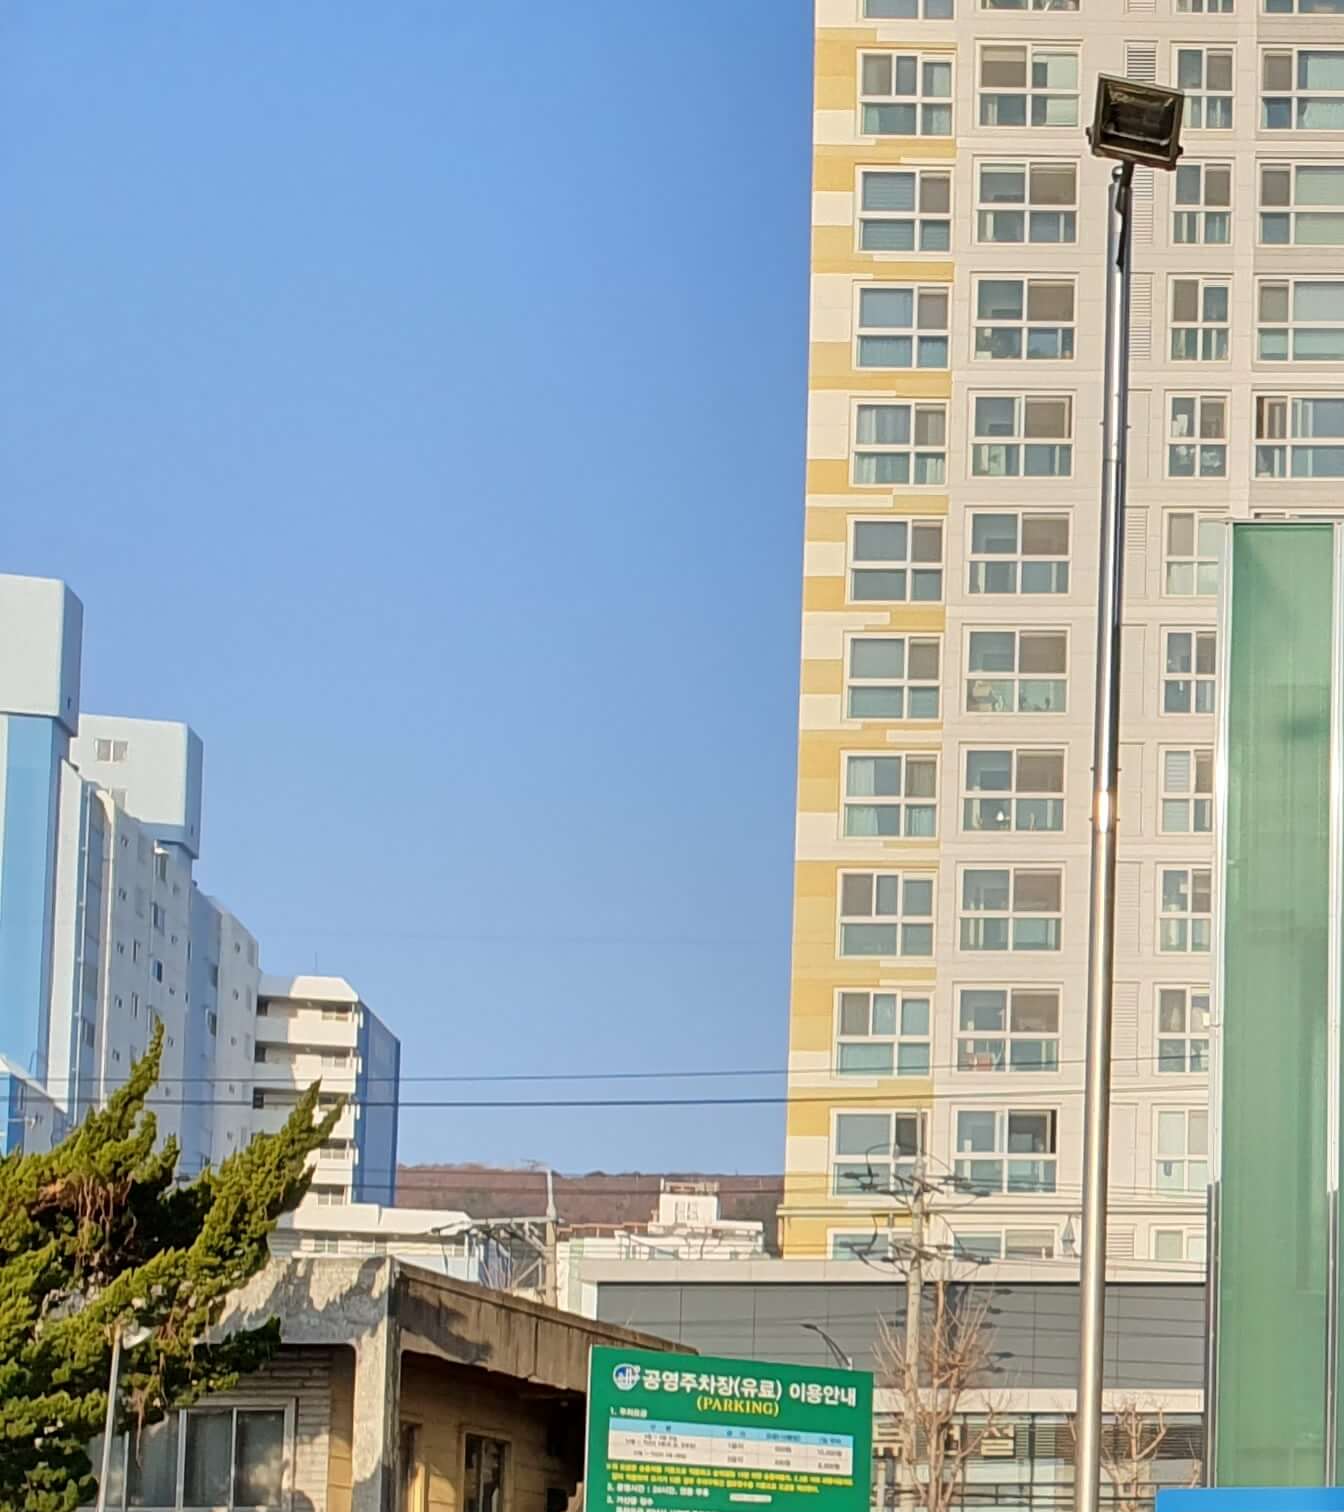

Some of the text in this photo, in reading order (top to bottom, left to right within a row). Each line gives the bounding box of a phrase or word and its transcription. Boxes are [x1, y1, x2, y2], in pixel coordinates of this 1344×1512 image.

[643, 1369, 857, 1408] 공영주차장(유료) 이용안내
[697, 1395, 779, 1417] (PARKING)
